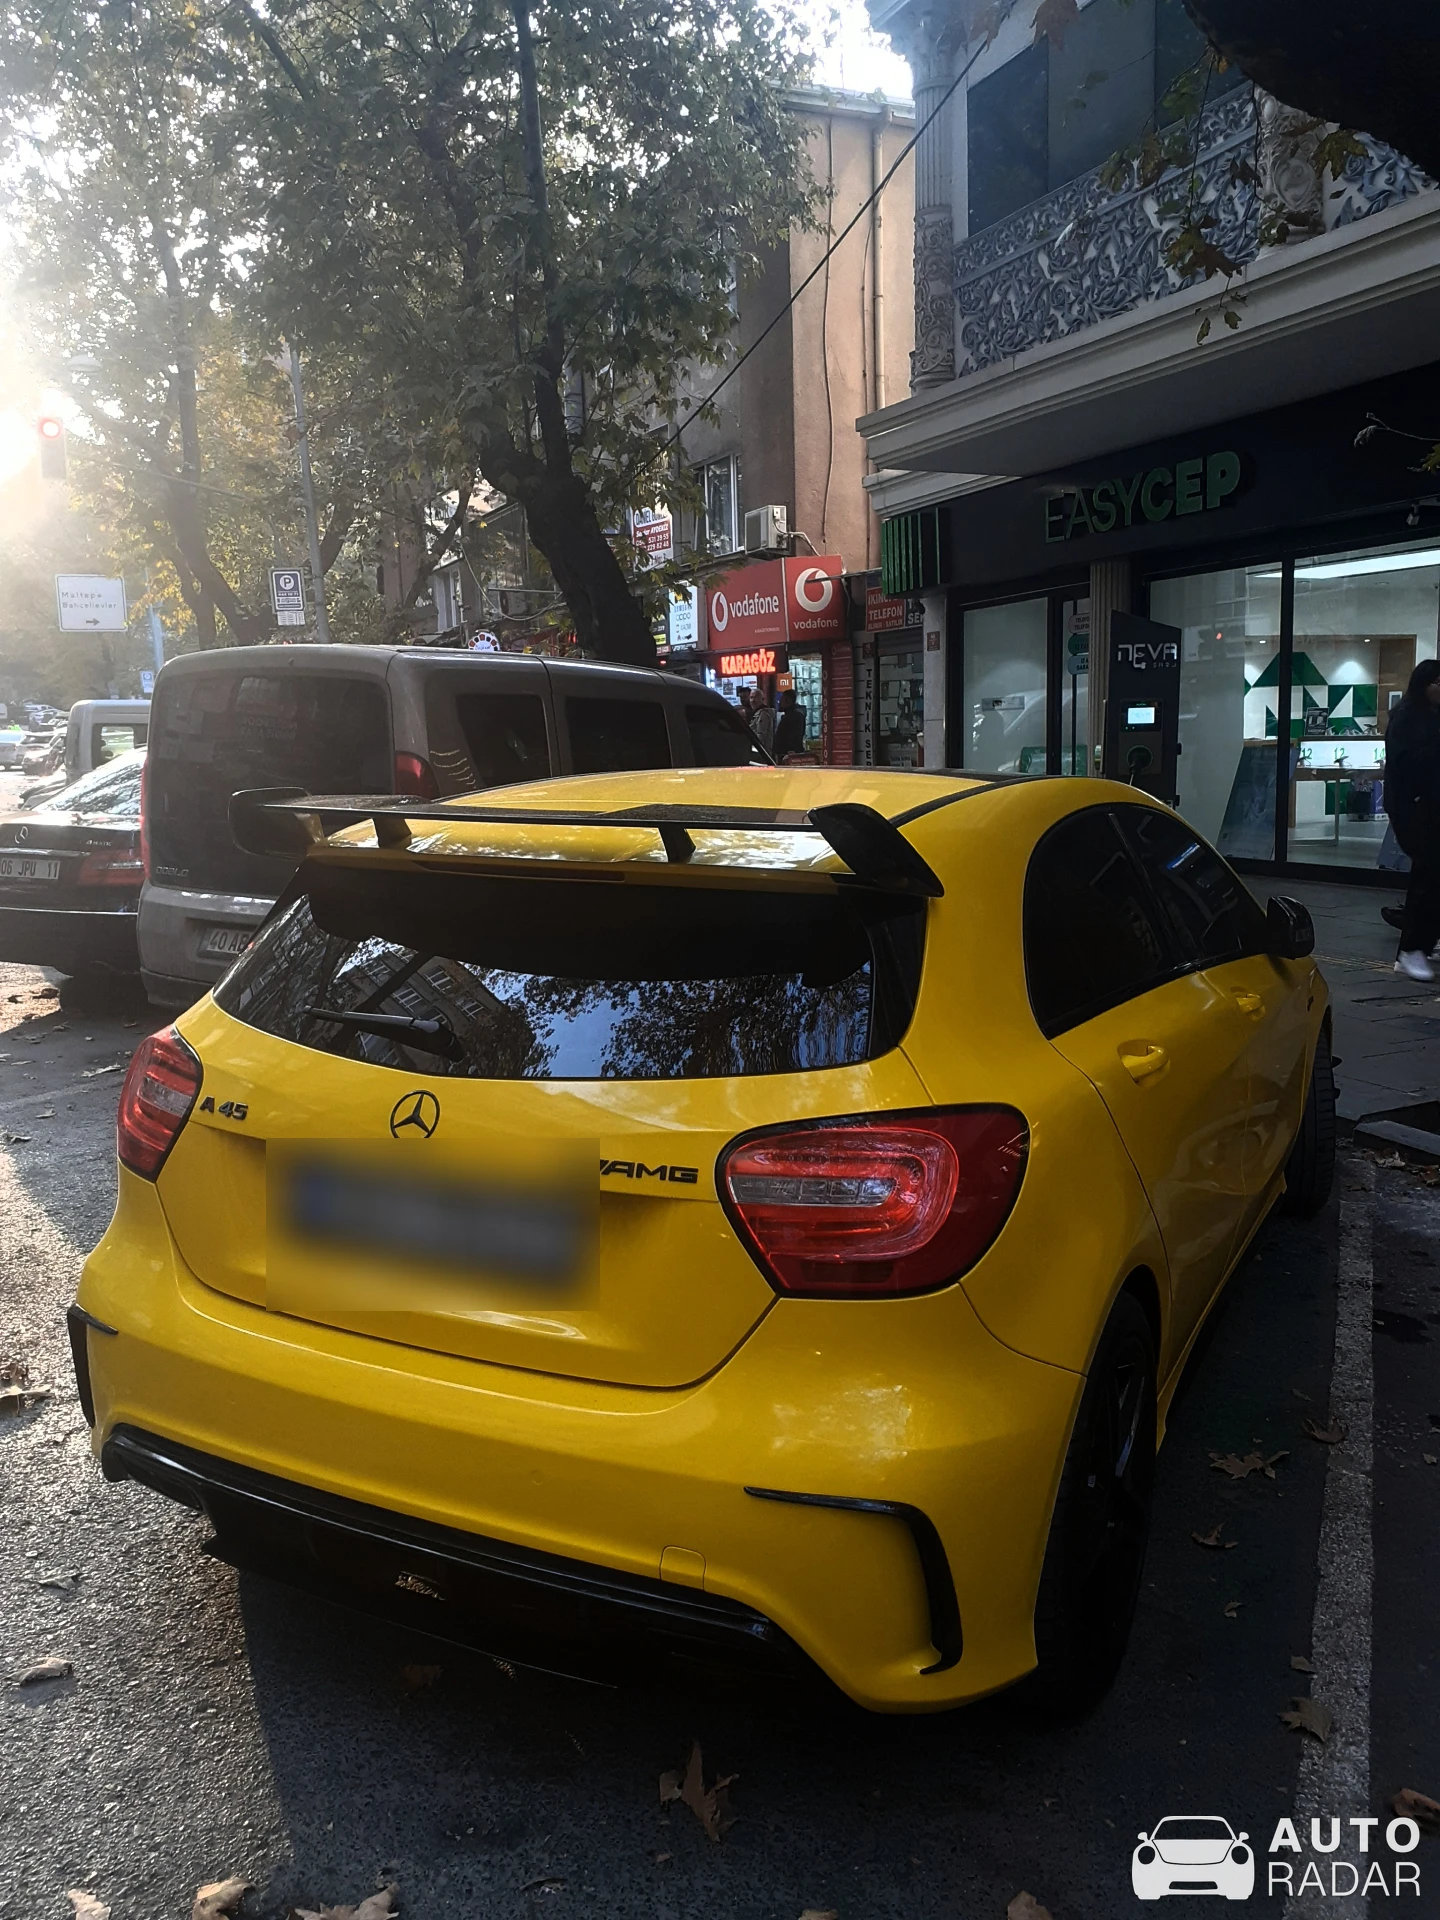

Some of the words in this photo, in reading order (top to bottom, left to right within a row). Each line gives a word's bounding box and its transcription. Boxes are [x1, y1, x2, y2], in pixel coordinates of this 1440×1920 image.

[1045, 451, 1241, 543] EASYCEP
[61, 592, 102, 600] Maltepe
[729, 592, 779, 618] vodafone
[794, 618, 838, 630] vodafone
[869, 605, 902, 620] TELEFON
[721, 648, 775, 674] KARAGÖZ
[864, 668, 873, 733] TEKNİK
[1, 859, 12, 876] 06
[18, 860, 36, 876] JPU
[47, 861, 57, 877] 11
[209, 931, 228, 951] 40
[200, 1096, 215, 1113] A
[218, 1101, 248, 1120] 45
[601, 1160, 699, 1184] AMG
